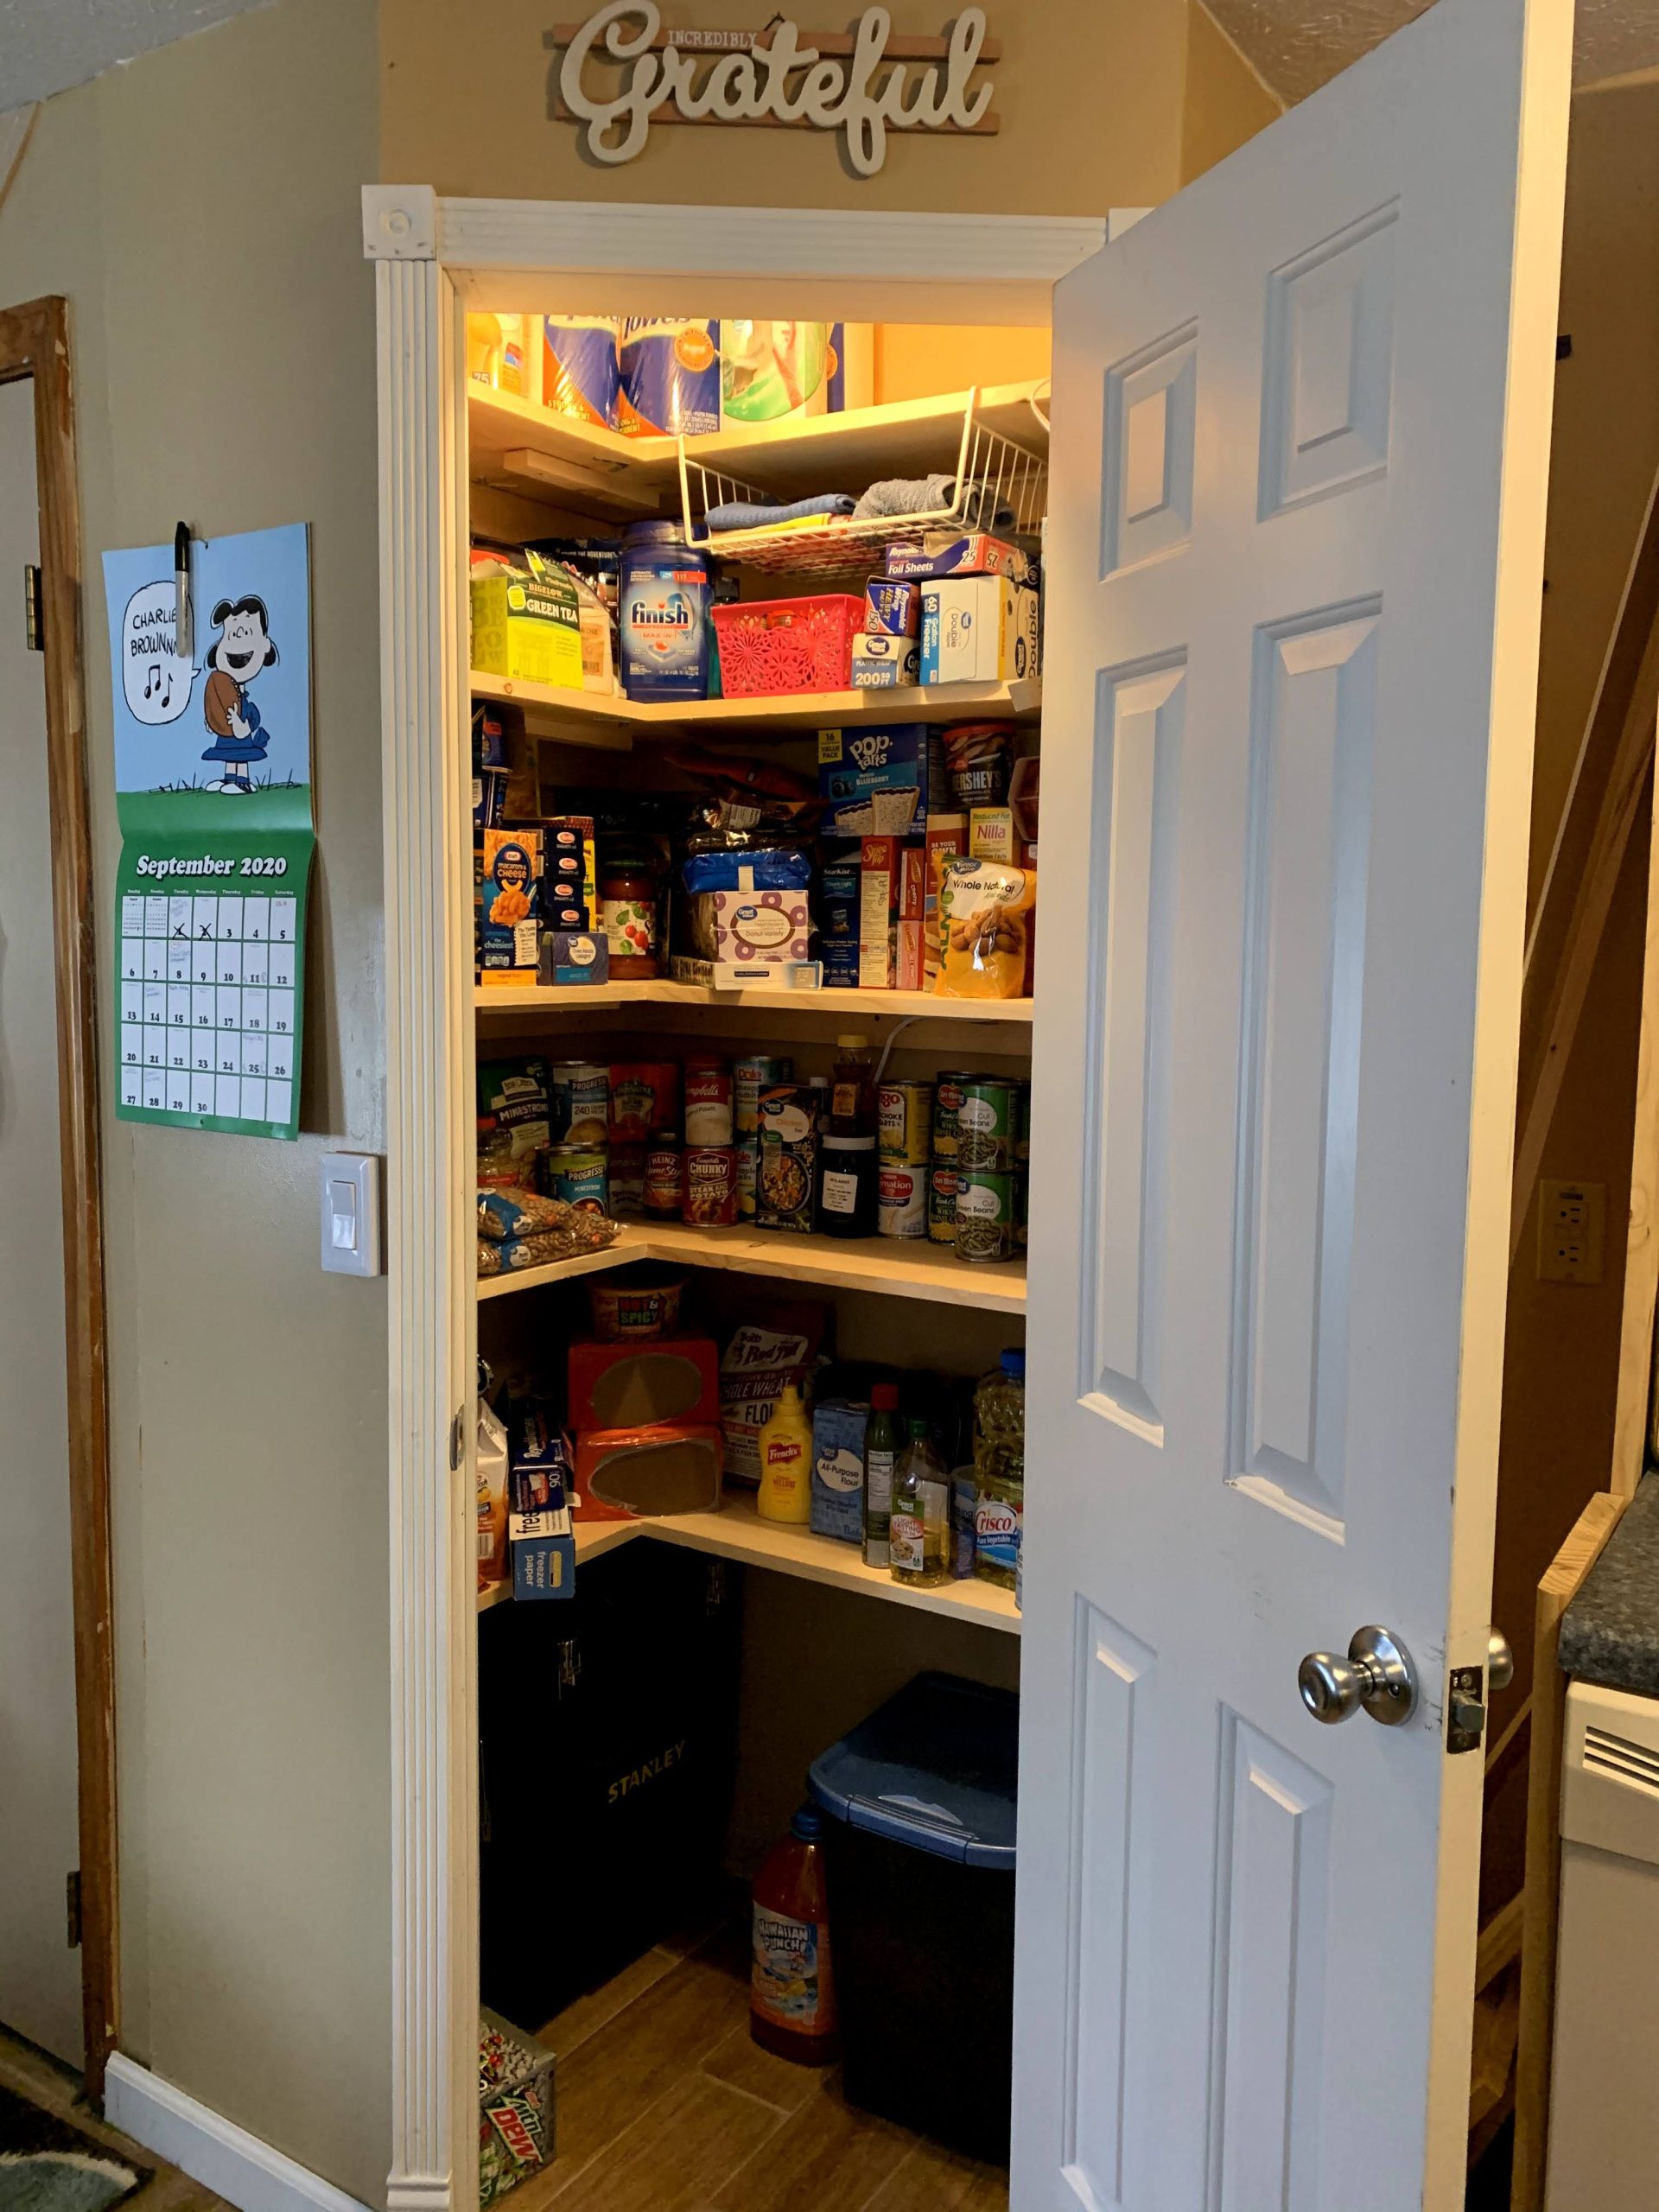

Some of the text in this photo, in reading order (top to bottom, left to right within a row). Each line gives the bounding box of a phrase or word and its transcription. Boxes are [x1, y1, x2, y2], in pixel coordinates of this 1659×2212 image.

[667, 29, 759, 48] INCREDIBLY
[560, 0, 994, 175] Grateful
[962, 550, 977, 563] 25
[987, 552, 999, 569] 25
[888, 562, 934, 575] Foil Sheets
[528, 582, 563, 598] BIGELOW
[892, 586, 901, 612] Wrap
[928, 595, 938, 613] 60
[526, 599, 578, 624] GREEN TEA
[631, 599, 689, 624] finish
[899, 588, 910, 631] Reynolds
[132, 608, 177, 630] CHARLIE
[867, 609, 880, 632] 150
[950, 613, 958, 648] Double
[923, 619, 931, 659] Freezer
[855, 672, 880, 686] 200
[825, 733, 835, 741] 16
[855, 775, 890, 786] BLUEBERRY
[951, 771, 1002, 791] HERSHEY'S
[977, 825, 1007, 840] Nilla
[931, 847, 957, 857] OWN
[137, 855, 288, 880] September 2020
[953, 880, 1015, 895] Whole Natual
[226, 929, 286, 939] 3 4 5
[153, 970, 157, 979] 7
[201, 972, 206, 981] 9
[173, 1014, 183, 1023] 15
[224, 1018, 232, 1027] 17
[276, 1022, 286, 1031] 19
[223, 1062, 232, 1071] 24
[250, 1065, 259, 1073] 25
[276, 1066, 285, 1075] 26
[738, 1069, 762, 1079] Dole
[571, 1077, 606, 1090] PROGRESS
[127, 1096, 135, 1104] 27
[173, 1101, 182, 1109] 29
[880, 1093, 900, 1108] go
[574, 1106, 590, 1116] 240
[969, 1118, 990, 1127] Beans
[651, 1155, 676, 1166] HEINZ
[690, 1162, 728, 1175] CHUNKY
[690, 1183, 729, 1195] STEAK AND
[879, 1179, 912, 1191] rnation
[690, 1189, 728, 1198] POTATO
[649, 1299, 659, 1310] &
[620, 1311, 658, 1325] SPICY
[753, 1376, 791, 1397] WHEAT
[769, 1446, 798, 1460] French's
[821, 1464, 859, 1478] All-Purpose
[841, 1476, 859, 1487] Flour
[516, 1512, 541, 1535] free
[893, 1522, 920, 1534] TASTING
[897, 1516, 916, 1527] LIGHT
[975, 1510, 1013, 1535] Crisco
[987, 1534, 1011, 1546] Vegetable
[524, 1554, 535, 1588] paper
[537, 1551, 547, 1589] freezer
[607, 1739, 685, 1804] STANLEY
[758, 1917, 810, 1942] HAWAIIAN
[763, 1935, 800, 1952] PUNCH
